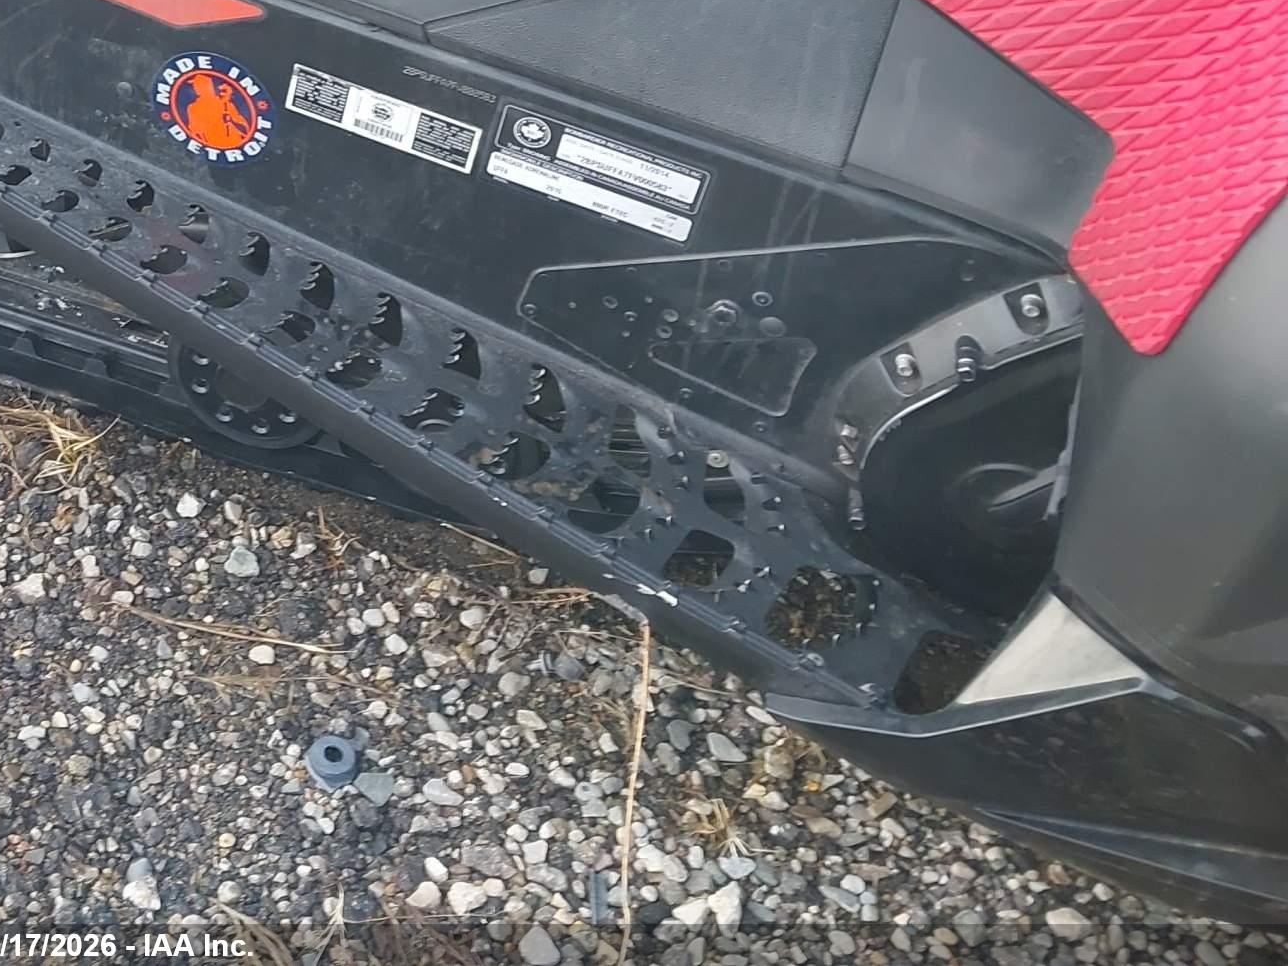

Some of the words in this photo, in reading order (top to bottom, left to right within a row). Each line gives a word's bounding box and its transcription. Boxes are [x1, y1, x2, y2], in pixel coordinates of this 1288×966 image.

[156, 55, 213, 106] MADE
[228, 66, 261, 97] IN
[168, 115, 272, 162] DETROIT
